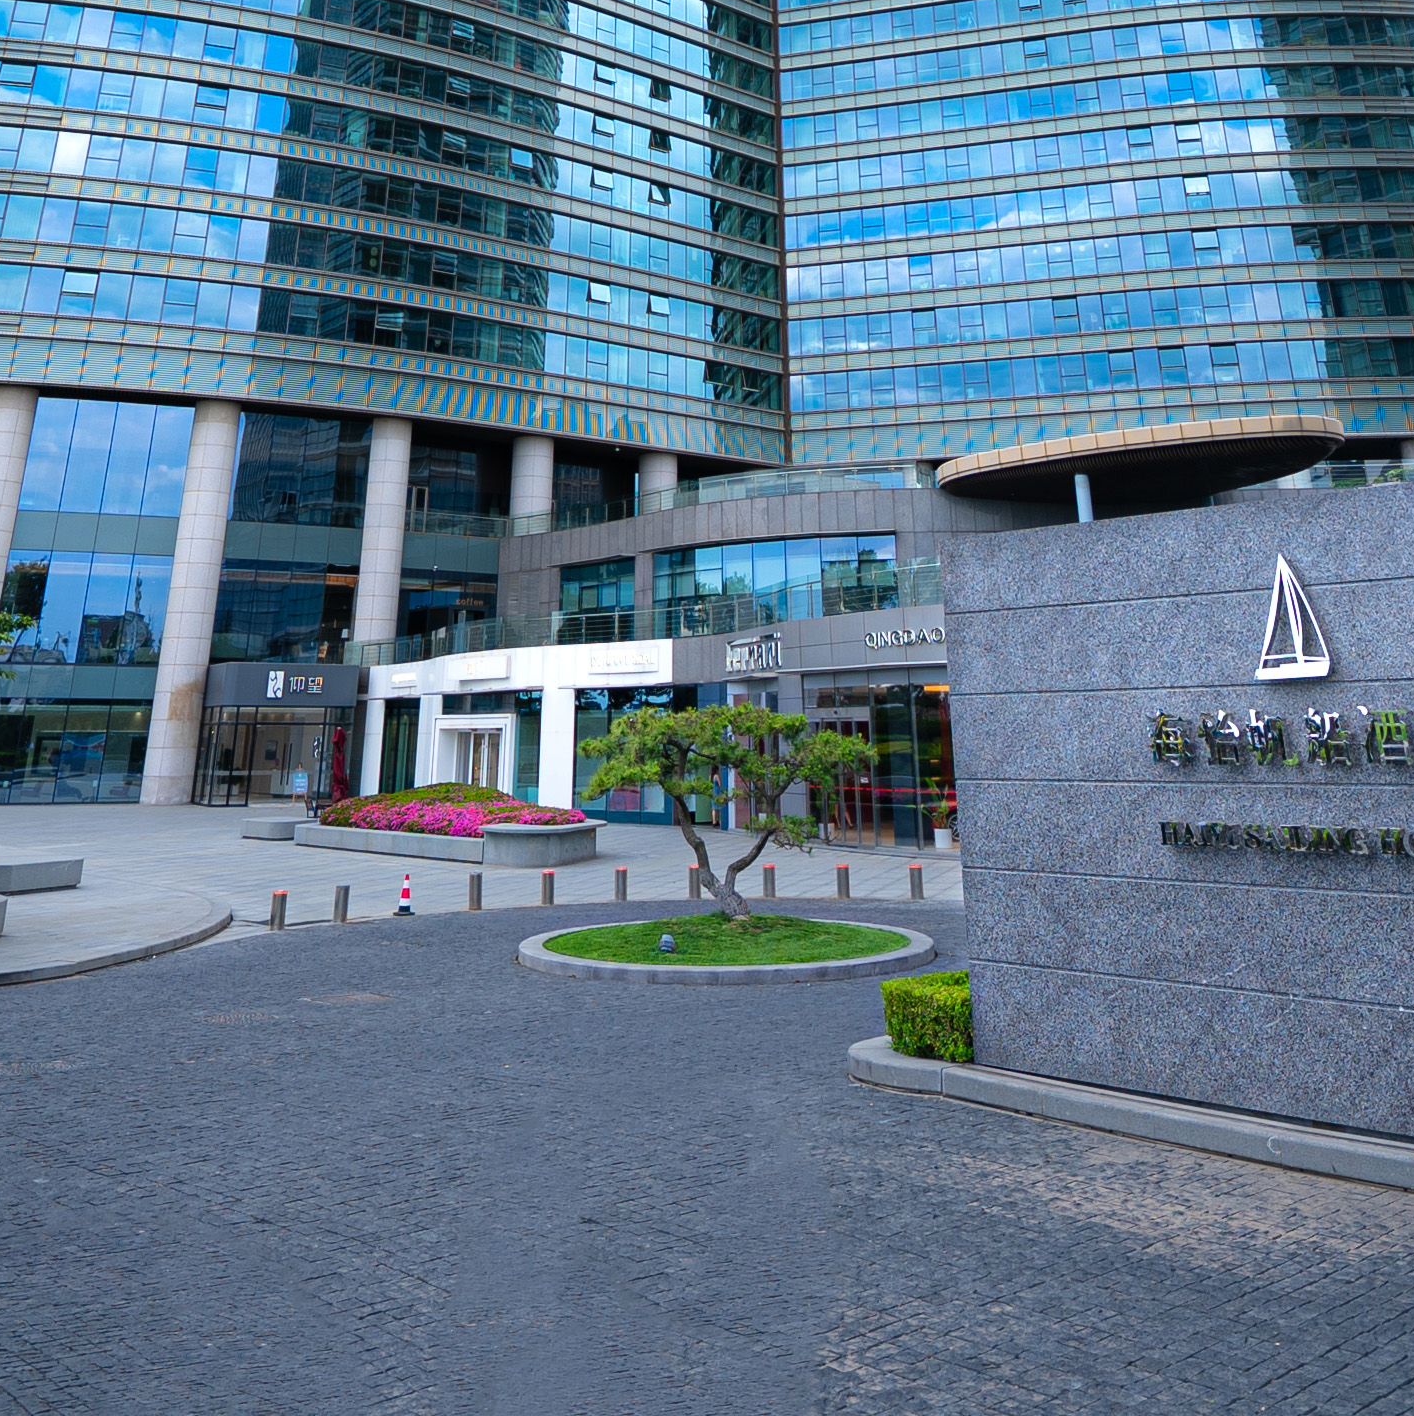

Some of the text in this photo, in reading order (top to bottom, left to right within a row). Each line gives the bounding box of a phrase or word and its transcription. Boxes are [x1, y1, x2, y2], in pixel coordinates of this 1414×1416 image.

[725, 631, 782, 673] Ferrari
[864, 626, 946, 650] QINGDAO
[288, 676, 323, 694] 仰望
[1242, 822, 1370, 856] SAILING
